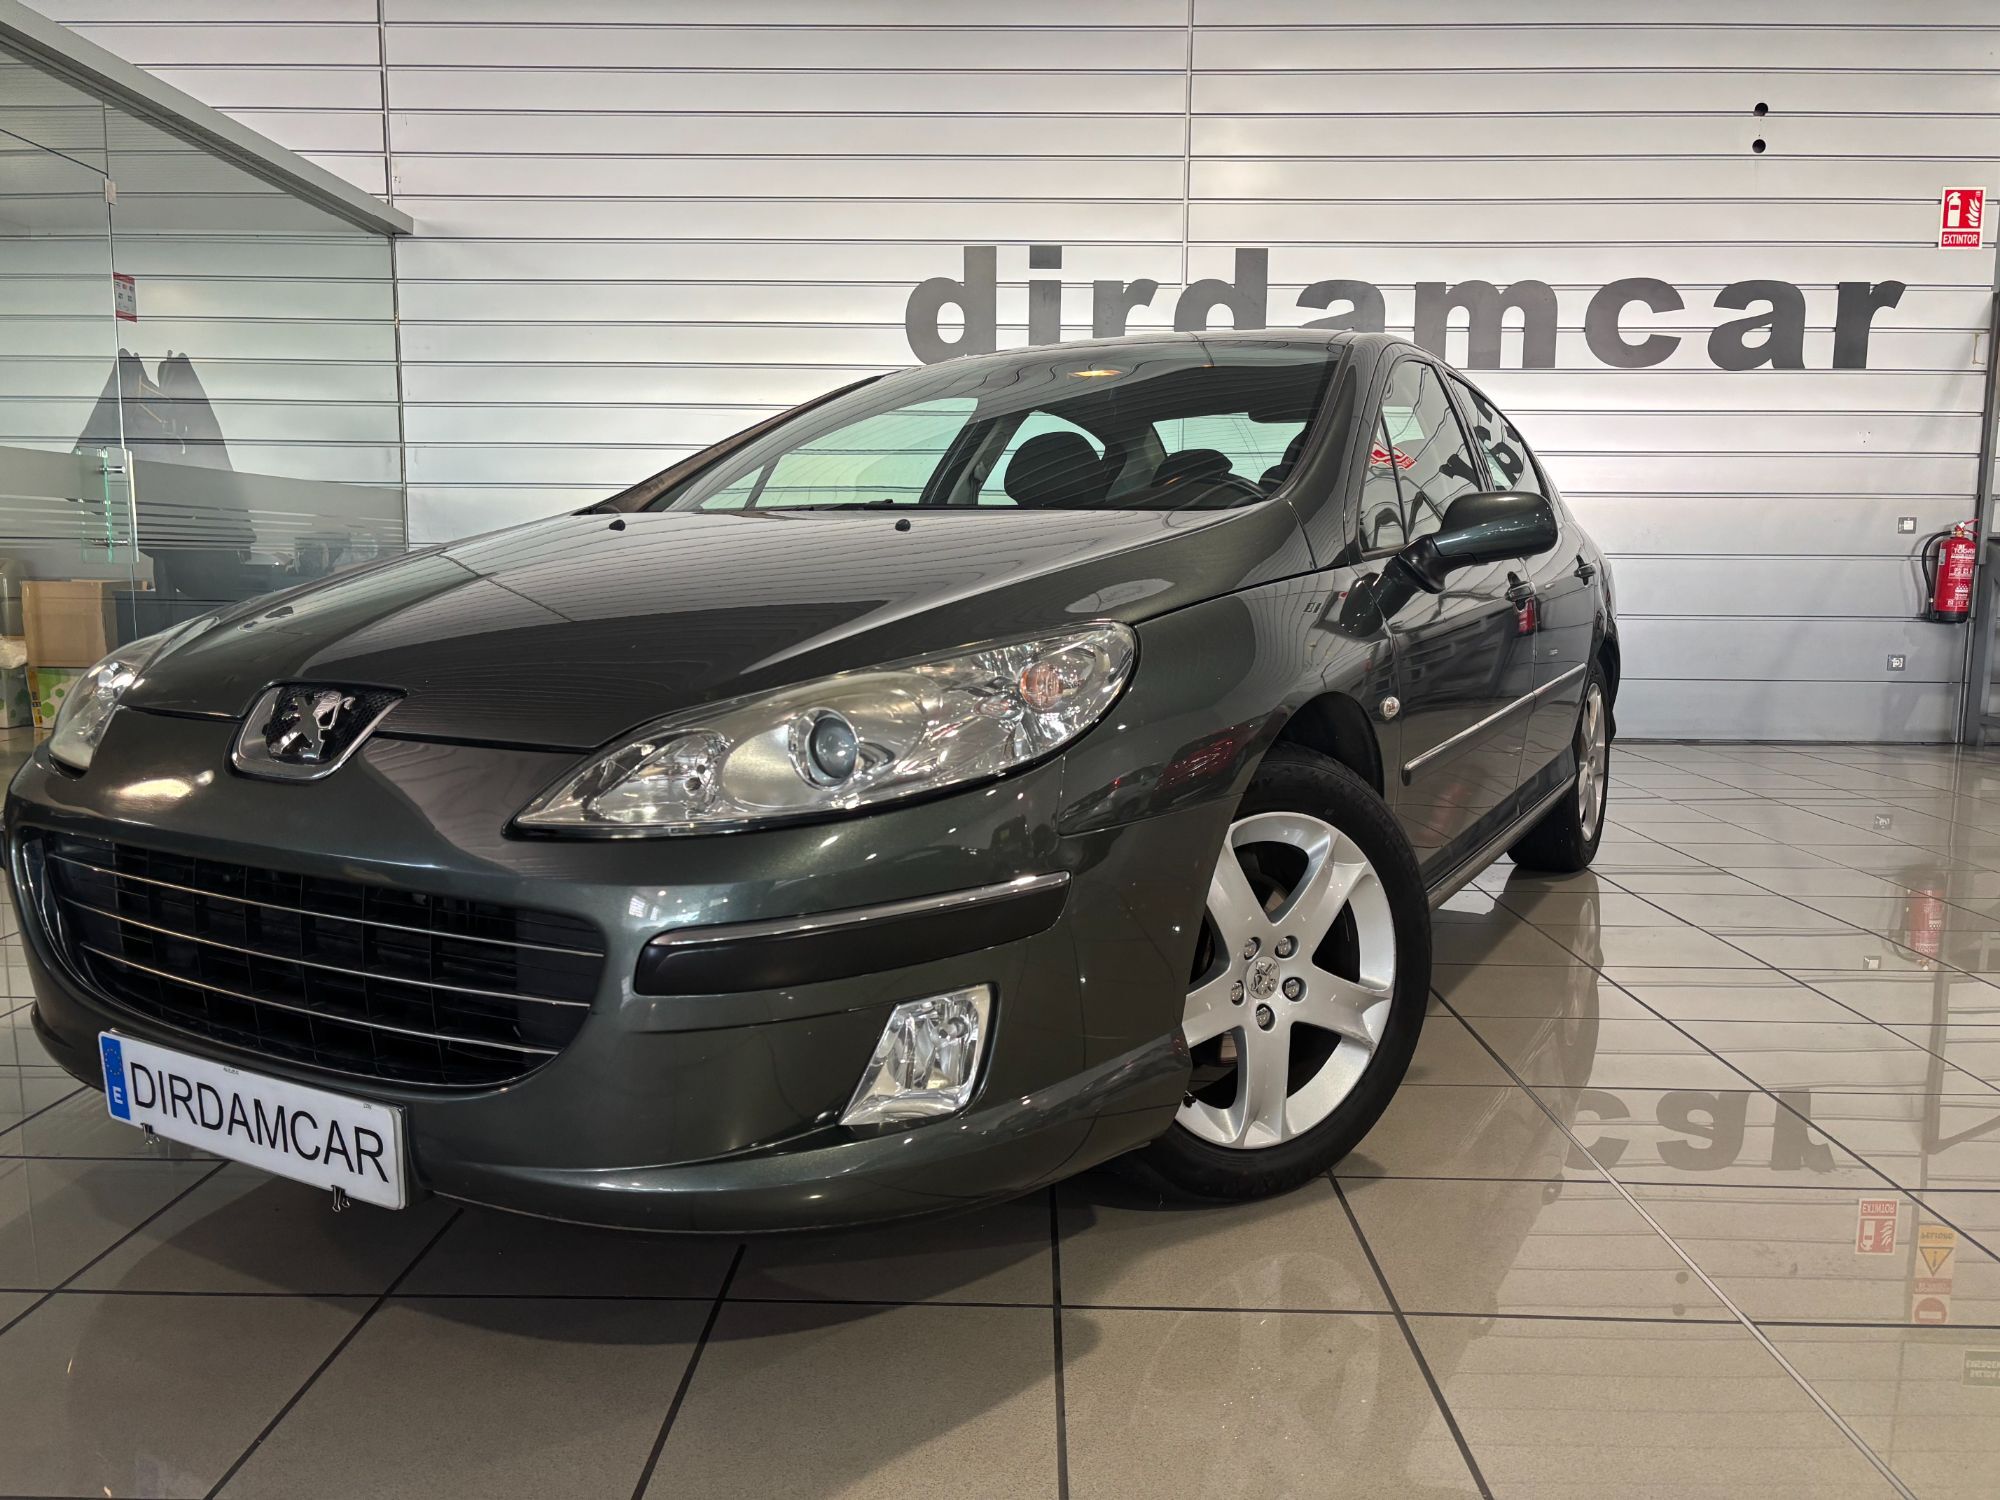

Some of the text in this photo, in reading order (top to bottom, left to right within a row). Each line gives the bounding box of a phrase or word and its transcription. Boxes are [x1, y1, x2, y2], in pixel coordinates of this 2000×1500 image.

[1943, 234, 1978, 245] EXTINTOR
[905, 245, 1907, 372] dirdamcar
[112, 1085, 124, 1106] E
[130, 1061, 390, 1184] DIRDAMCAR
